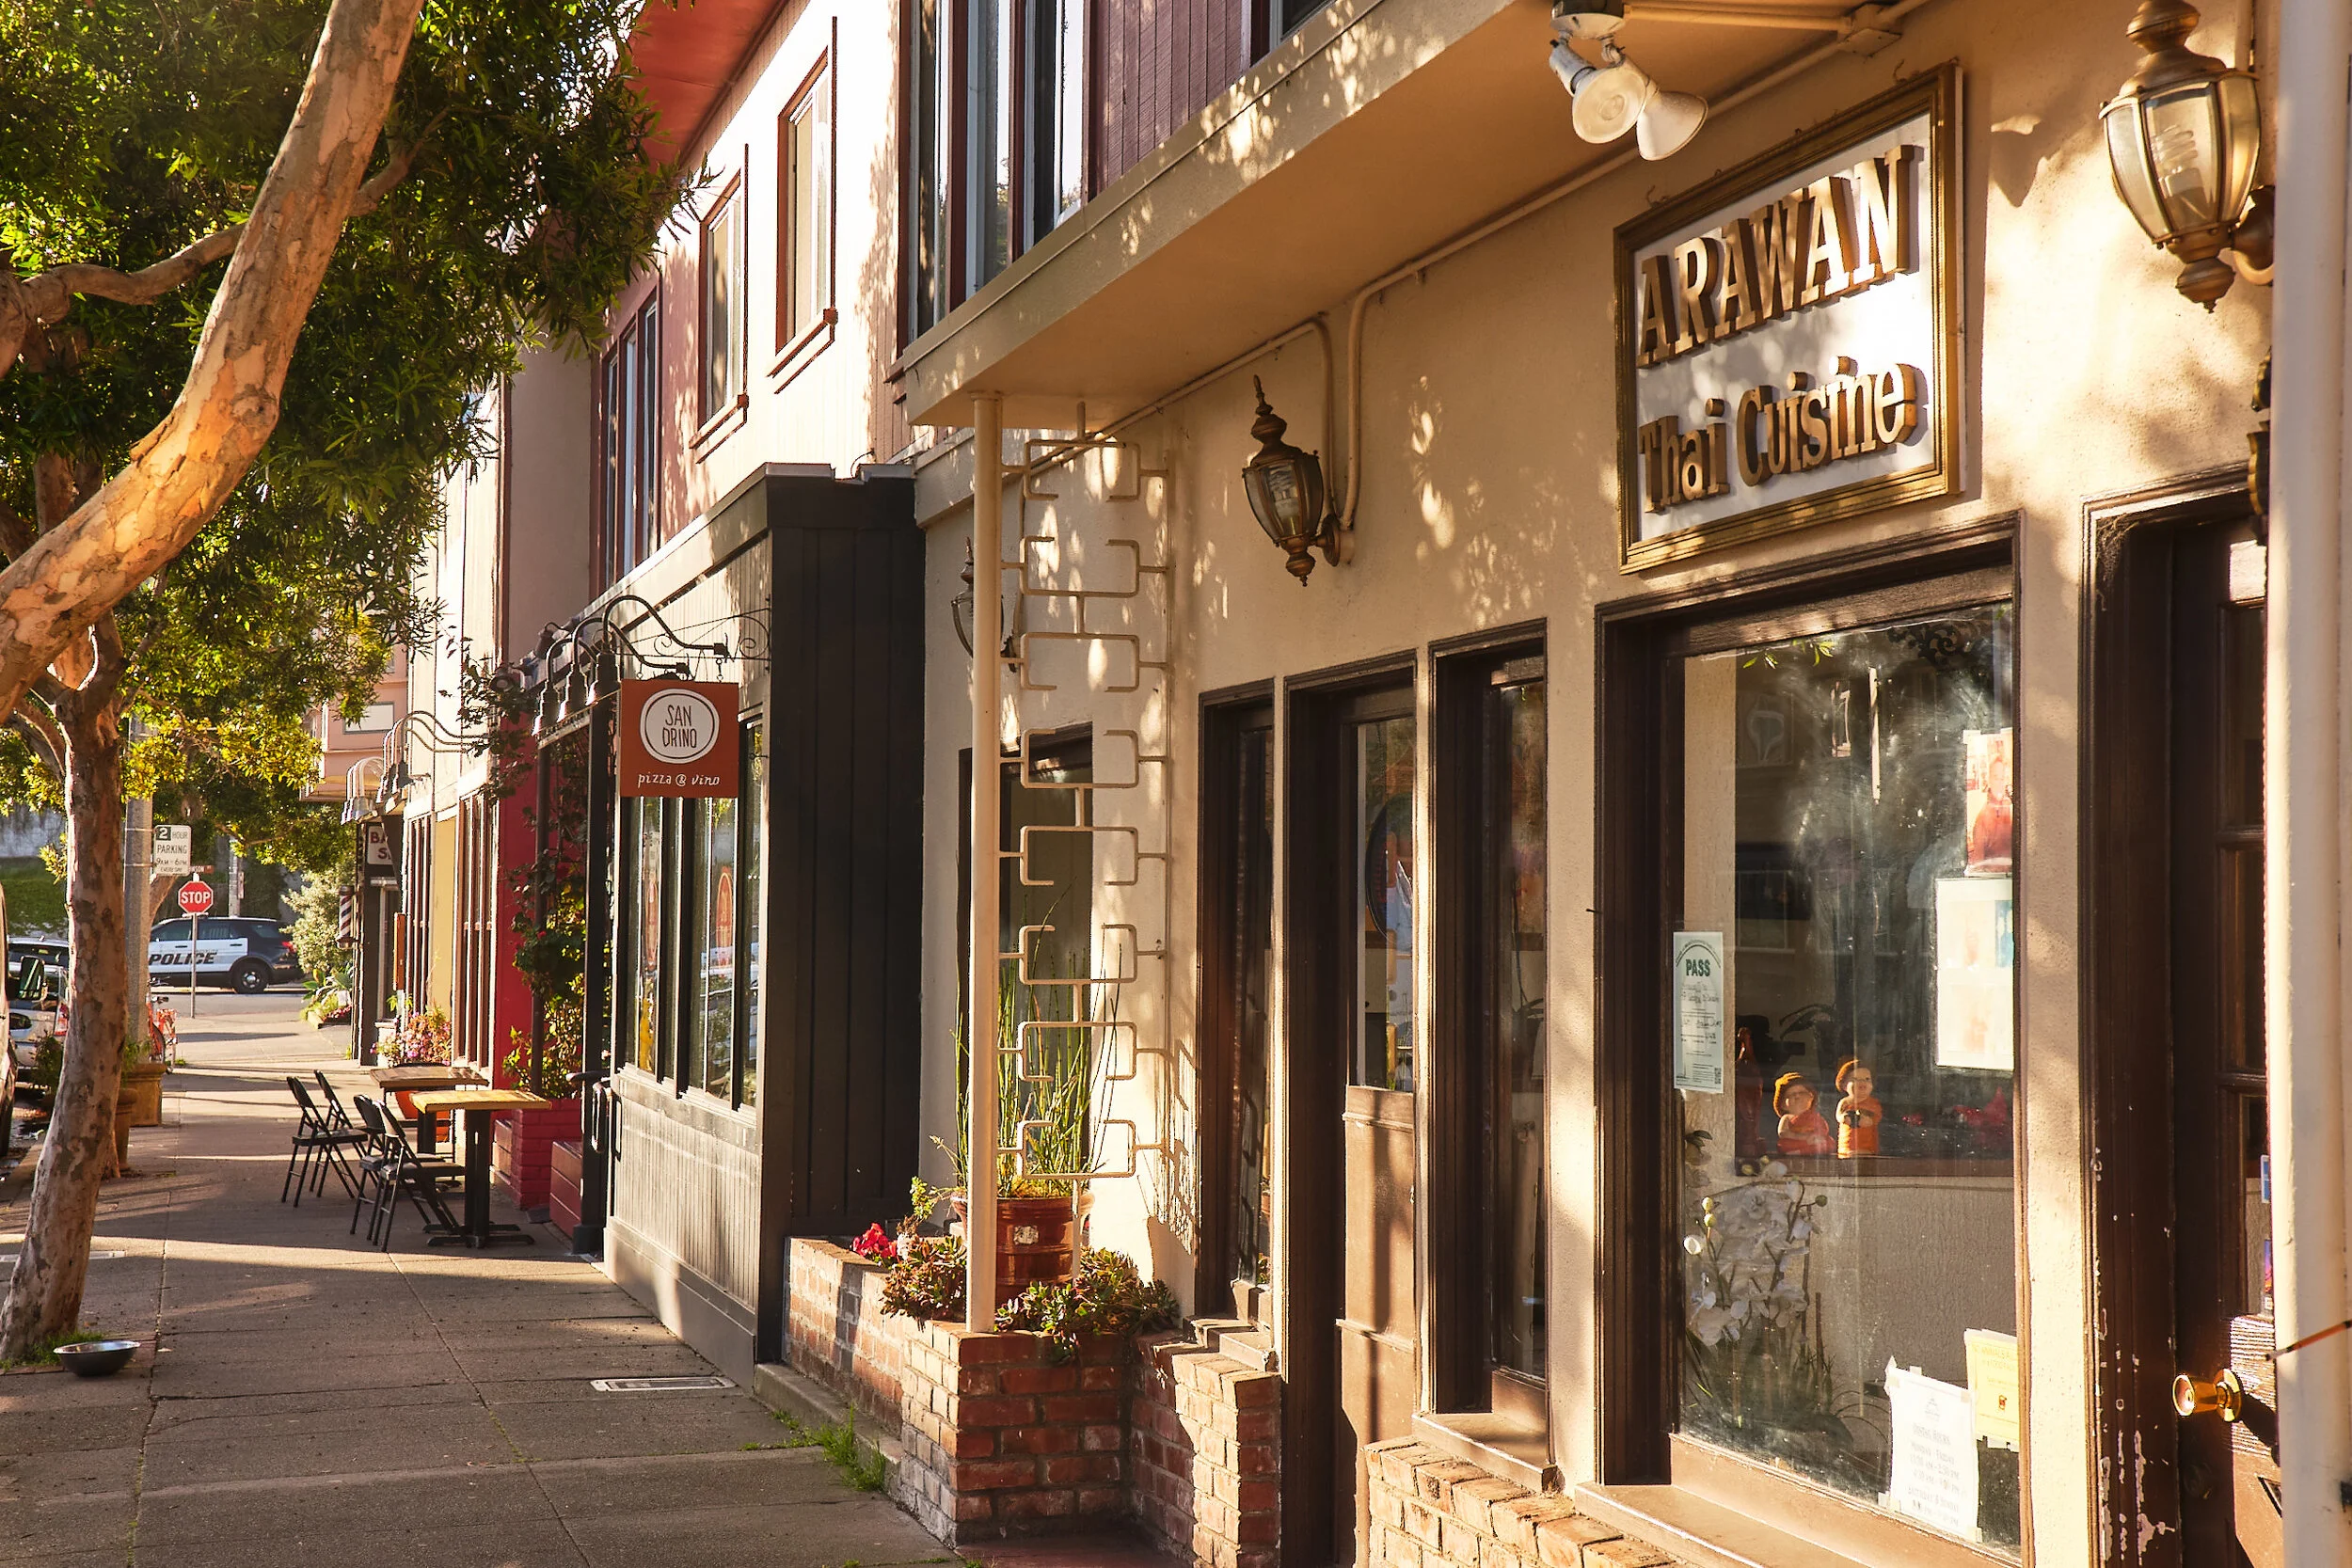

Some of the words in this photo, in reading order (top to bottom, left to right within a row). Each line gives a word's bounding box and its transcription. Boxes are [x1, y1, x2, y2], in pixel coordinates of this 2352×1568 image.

[1636, 144, 1923, 369] ARAWAN
[1639, 397, 1730, 514] Thai
[1737, 356, 1919, 486] Cuisine
[665, 705, 692, 726] SAN
[662, 727, 697, 748] DRINO
[638, 771, 672, 788] pizza
[675, 774, 687, 786] &
[691, 774, 720, 785] vino
[159, 827, 168, 839] 2
[157, 845, 187, 853] PARKING
[181, 891, 211, 904] STOP
[149, 953, 217, 965] POLICE
[1685, 958, 1710, 977] PASS
